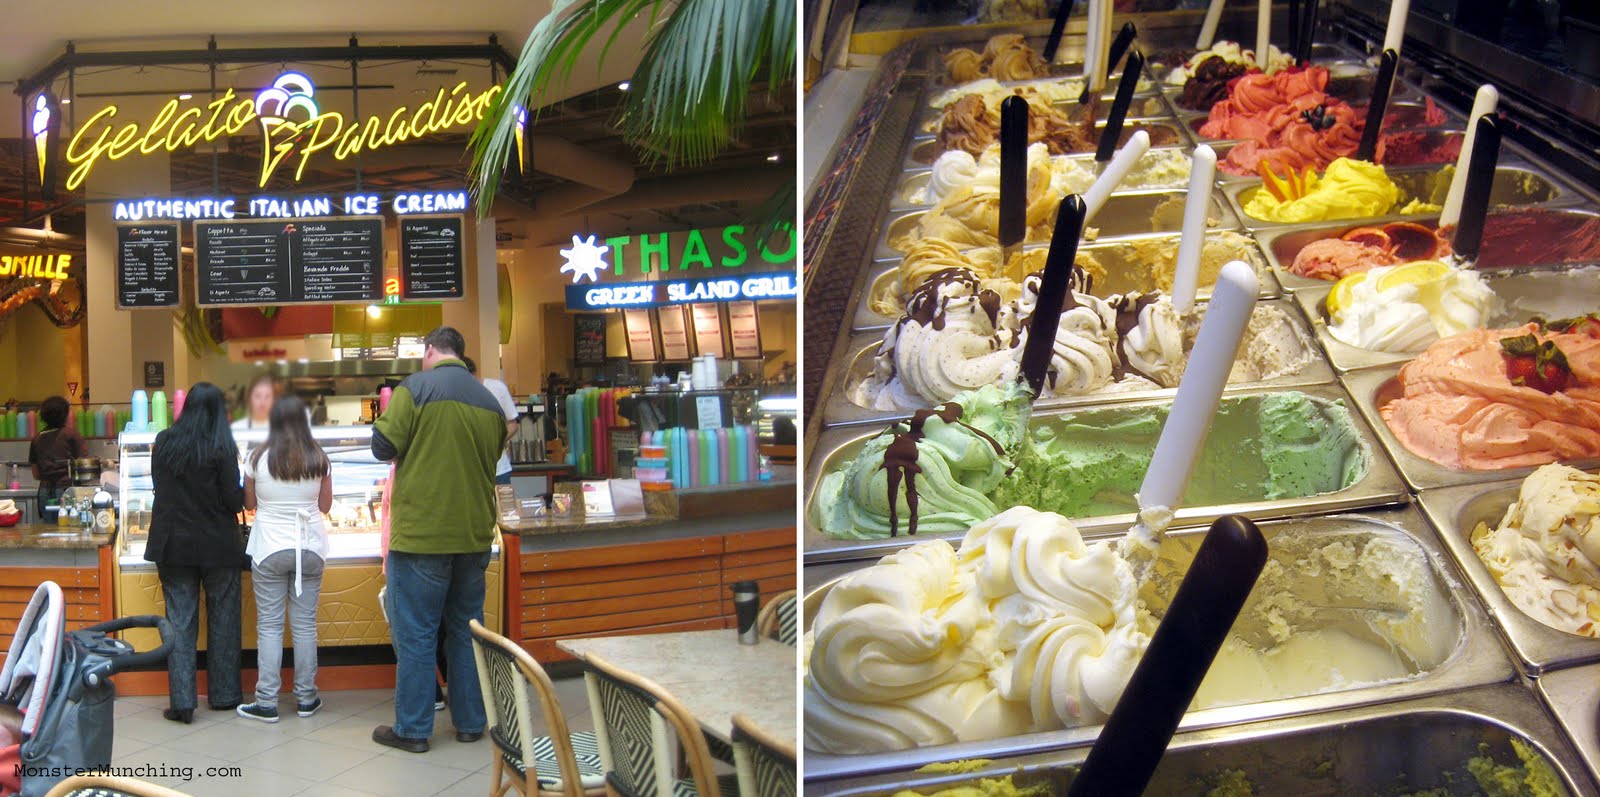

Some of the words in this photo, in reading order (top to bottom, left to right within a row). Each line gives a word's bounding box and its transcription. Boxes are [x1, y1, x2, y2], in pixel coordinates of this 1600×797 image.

[66, 88, 256, 190] Gelato
[115, 199, 235, 220] AUTHENTIC
[250, 198, 330, 218] ITALIAN
[345, 196, 379, 215] ICE
[393, 192, 465, 214] CREAM
[207, 227, 234, 236] Coppetta
[585, 285, 654, 306] GREEK
